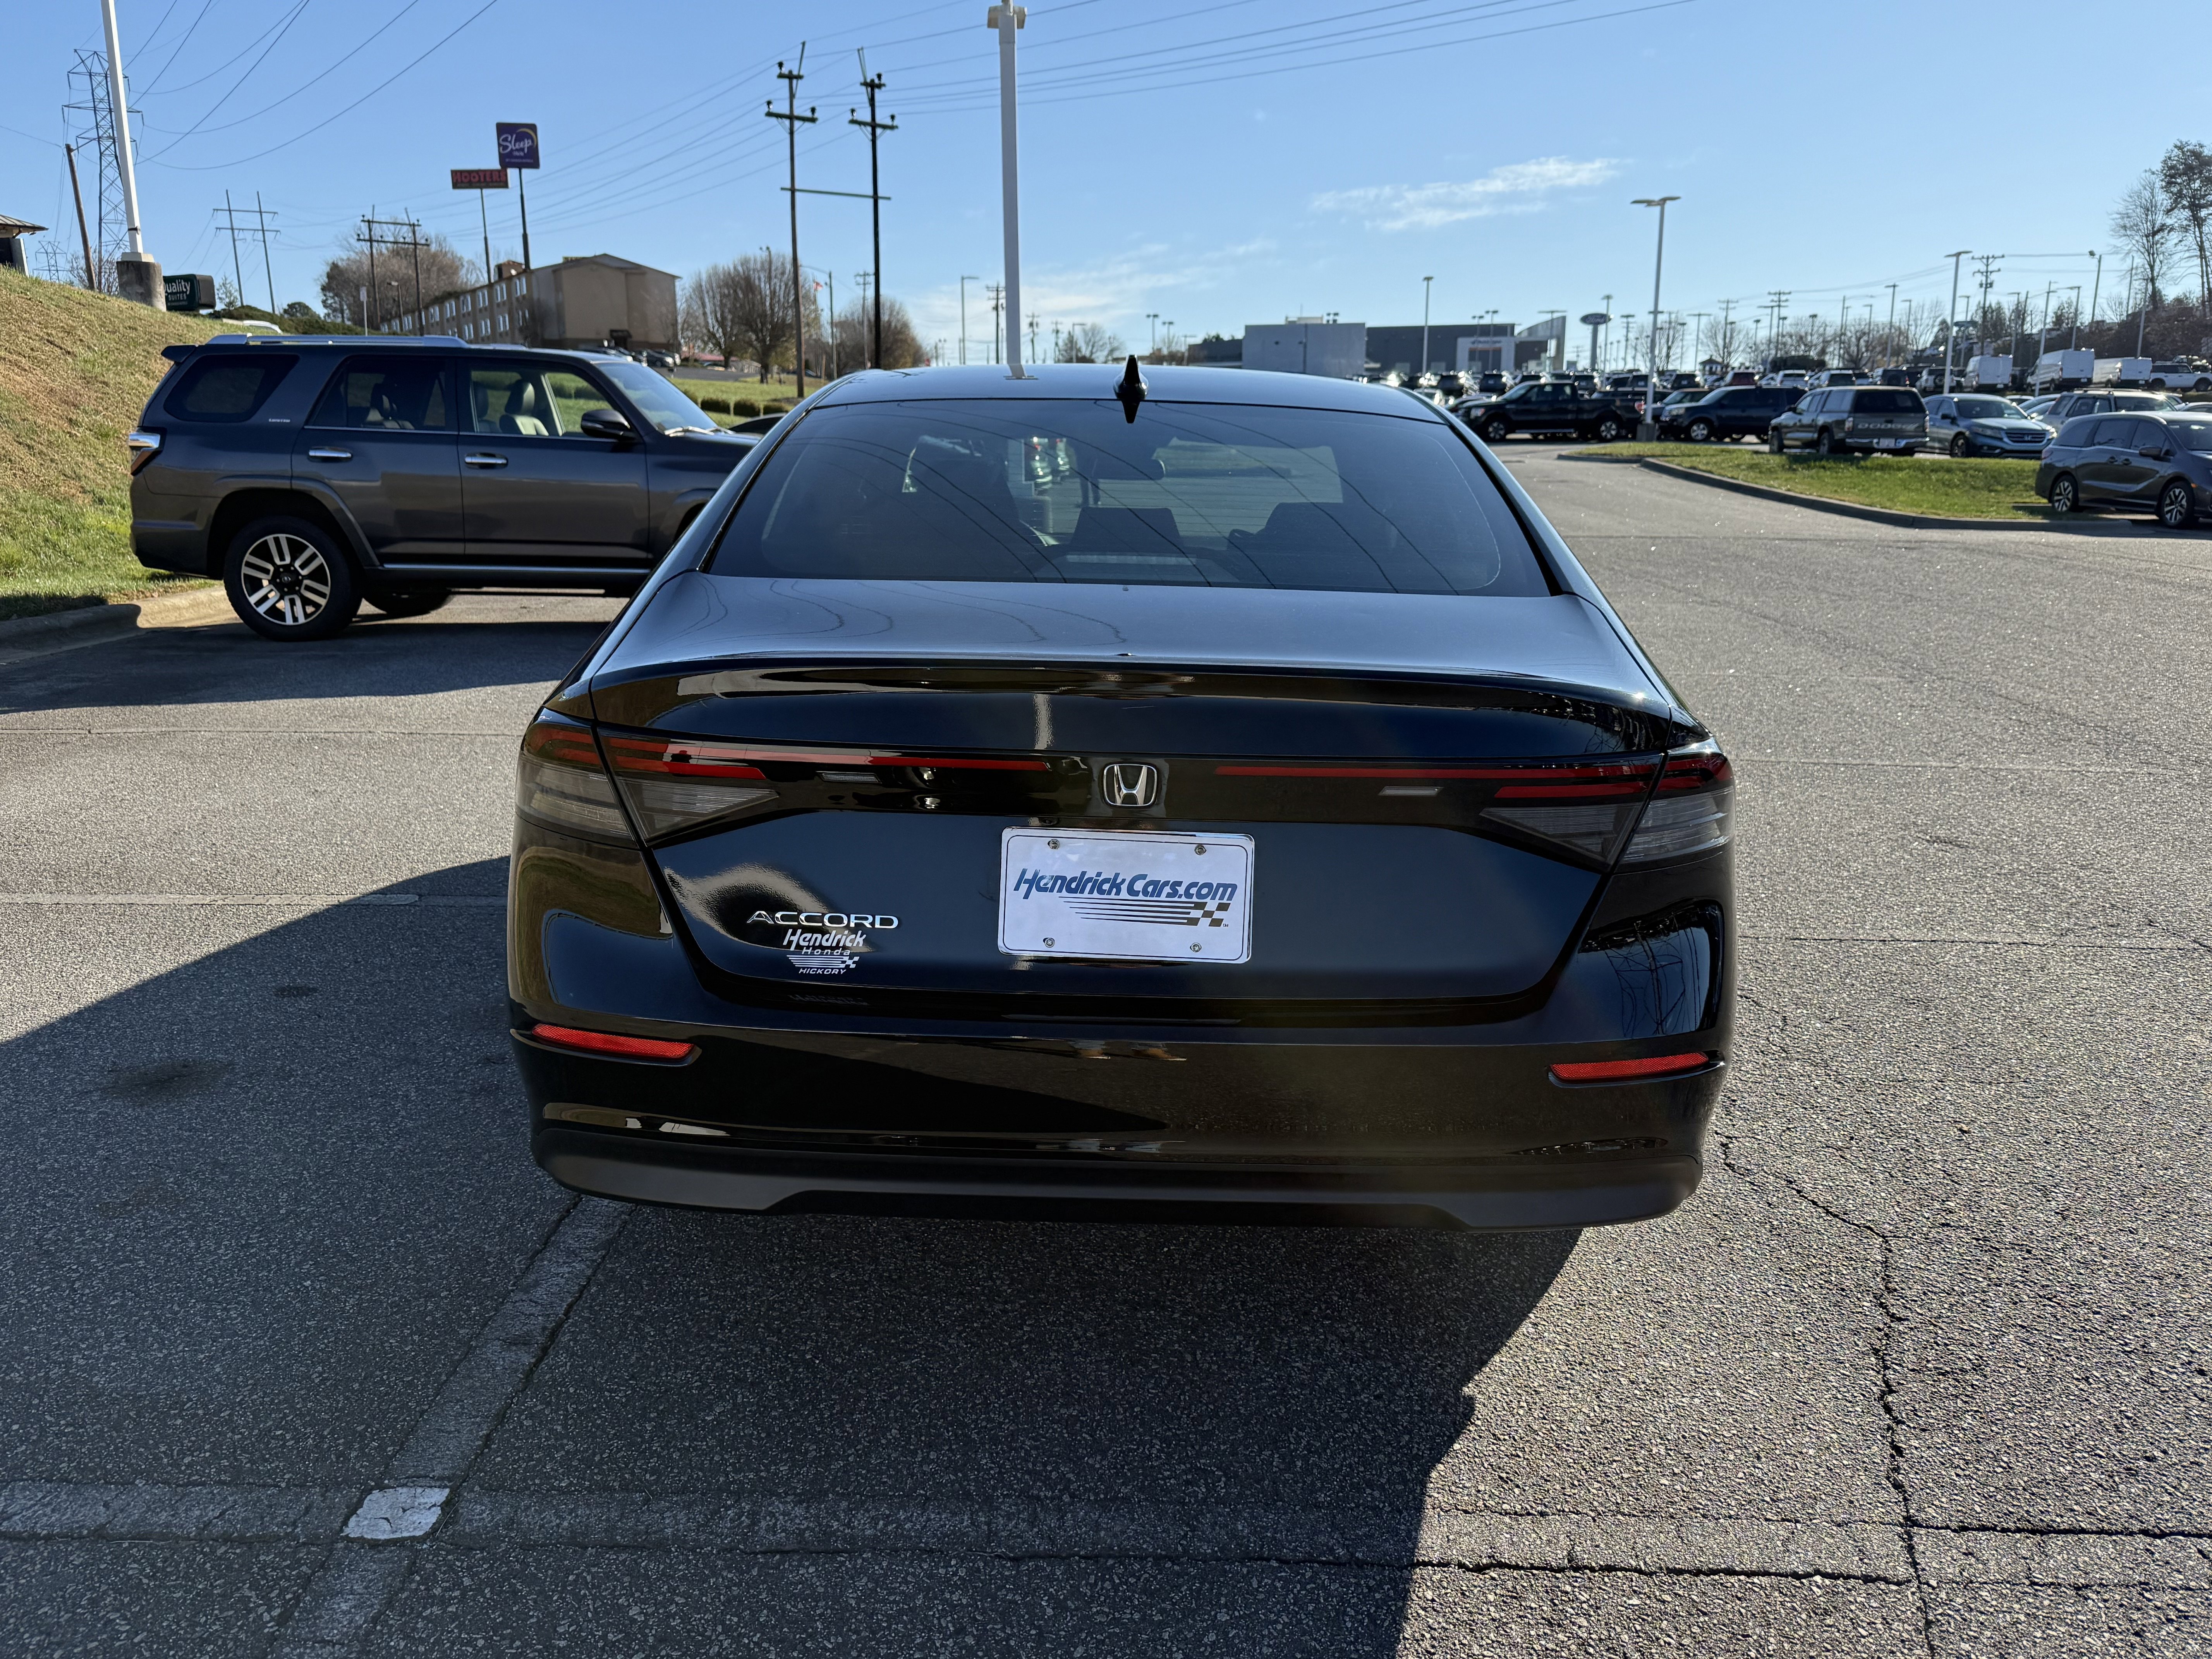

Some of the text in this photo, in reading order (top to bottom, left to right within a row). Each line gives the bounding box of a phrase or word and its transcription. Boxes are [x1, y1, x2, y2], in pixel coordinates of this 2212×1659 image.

[499, 133, 532, 154] Sleep
[452, 170, 507, 183] HOOTERS
[164, 279, 190, 296] uality
[168, 293, 186, 301] SUITES
[747, 910, 898, 929] ACCORD
[783, 929, 866, 951] Hendrick
